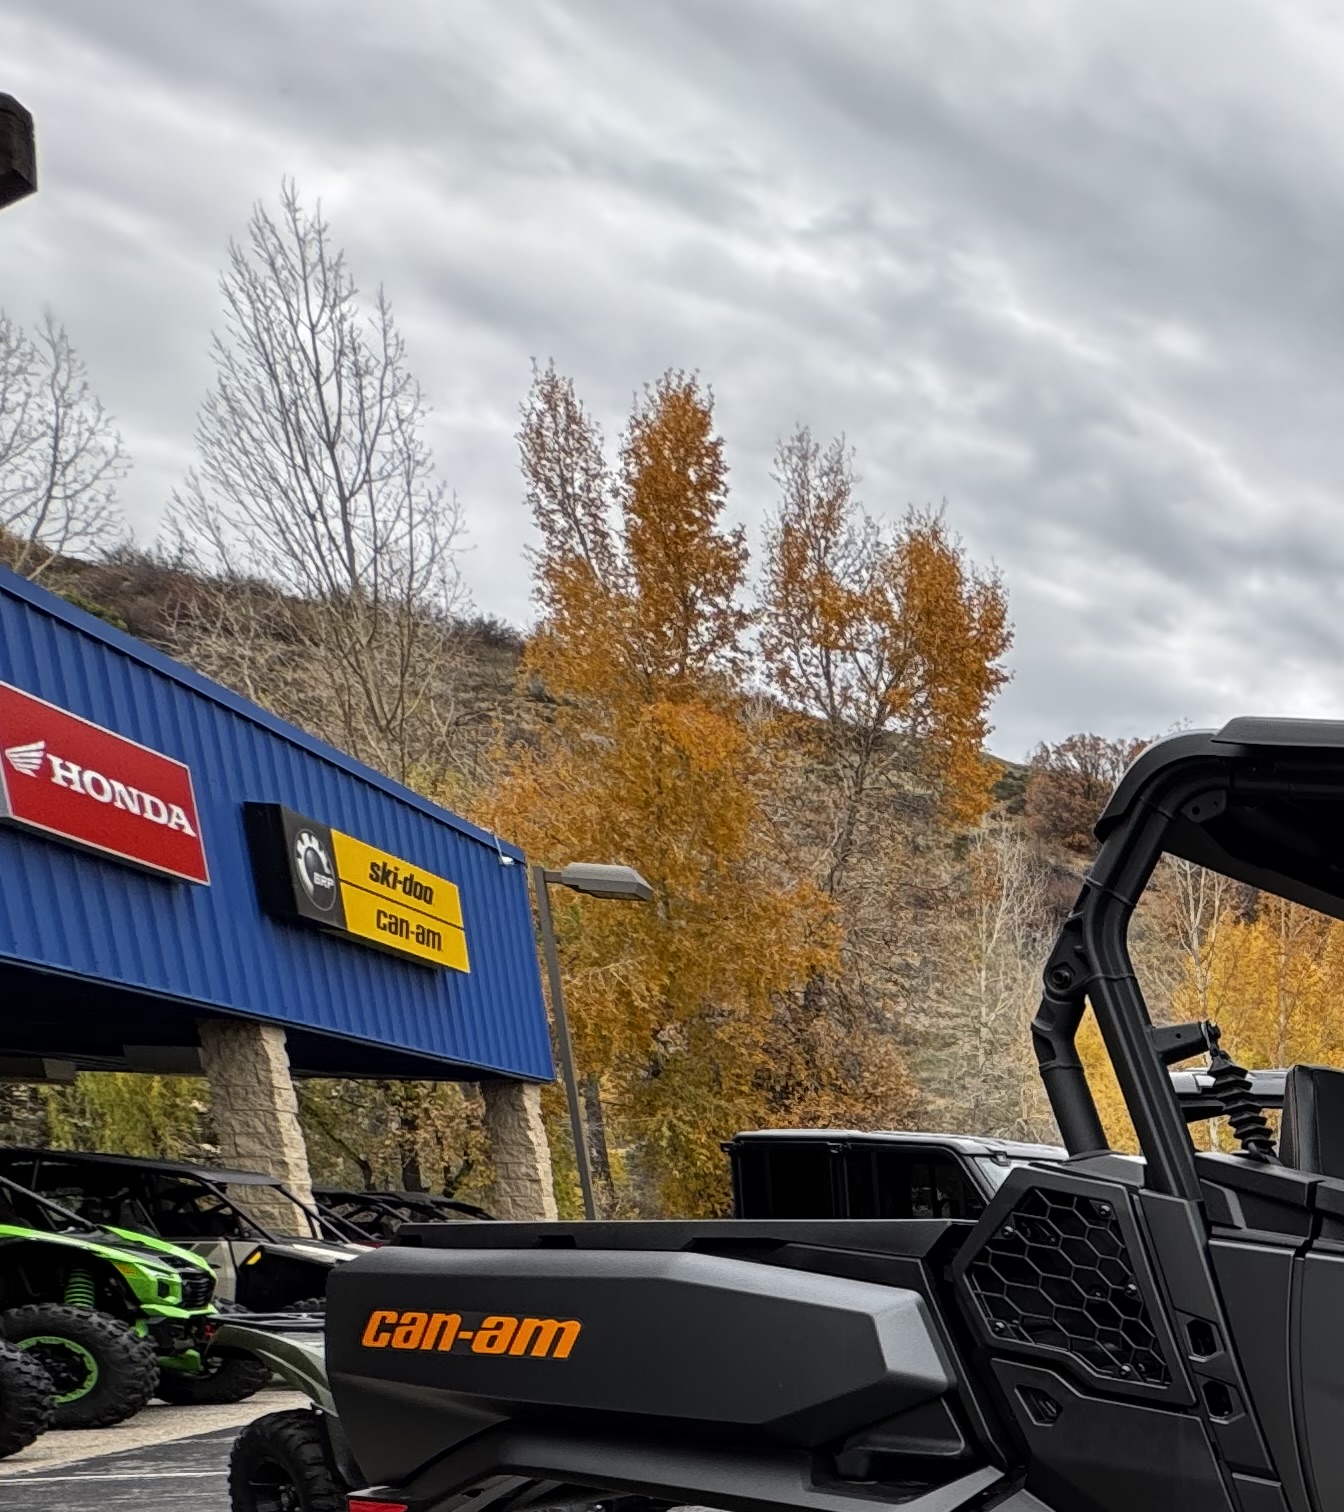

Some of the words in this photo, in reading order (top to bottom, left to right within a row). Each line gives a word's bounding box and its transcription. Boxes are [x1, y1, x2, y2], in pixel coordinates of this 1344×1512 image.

[46, 753, 197, 838] HONDA
[369, 861, 434, 905] ski-doo
[376, 909, 442, 951] can-am
[361, 1310, 582, 1359] can-am
